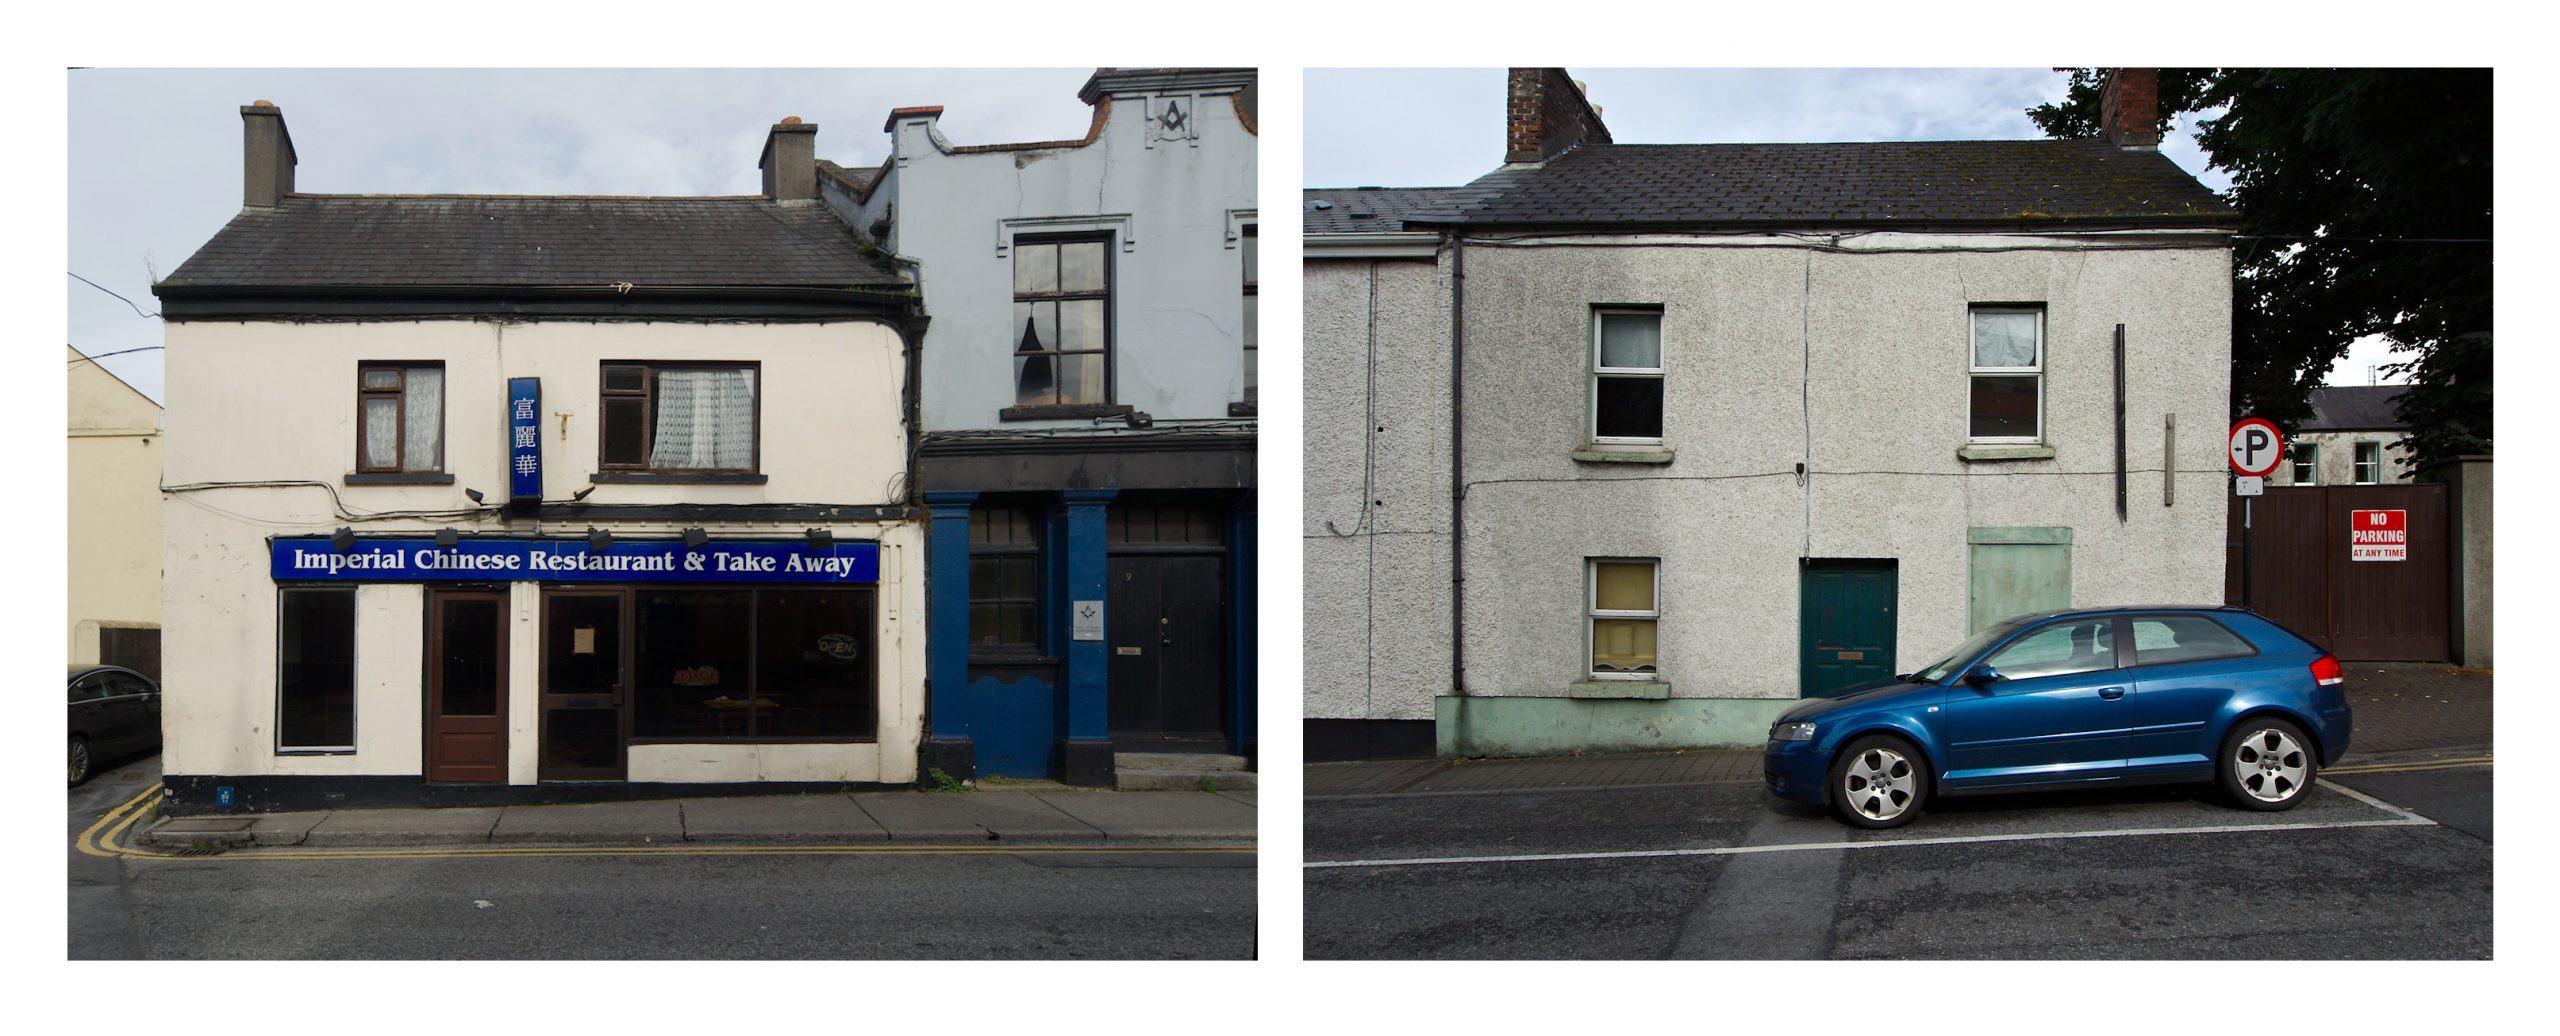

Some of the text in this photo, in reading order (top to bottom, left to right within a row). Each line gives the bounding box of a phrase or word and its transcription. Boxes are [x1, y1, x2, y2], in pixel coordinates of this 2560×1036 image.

[513, 397, 537, 477] 富麗華
[2246, 430, 2269, 466] P
[2370, 513, 2387, 526] NO
[2353, 530, 2404, 543] PARKING
[2353, 549, 2405, 557] AT ANY TIME
[294, 548, 855, 578] Imperial Chinese Restaurant & Take Away
[1125, 571, 1132, 582] 9
[818, 641, 852, 653] OPEN
